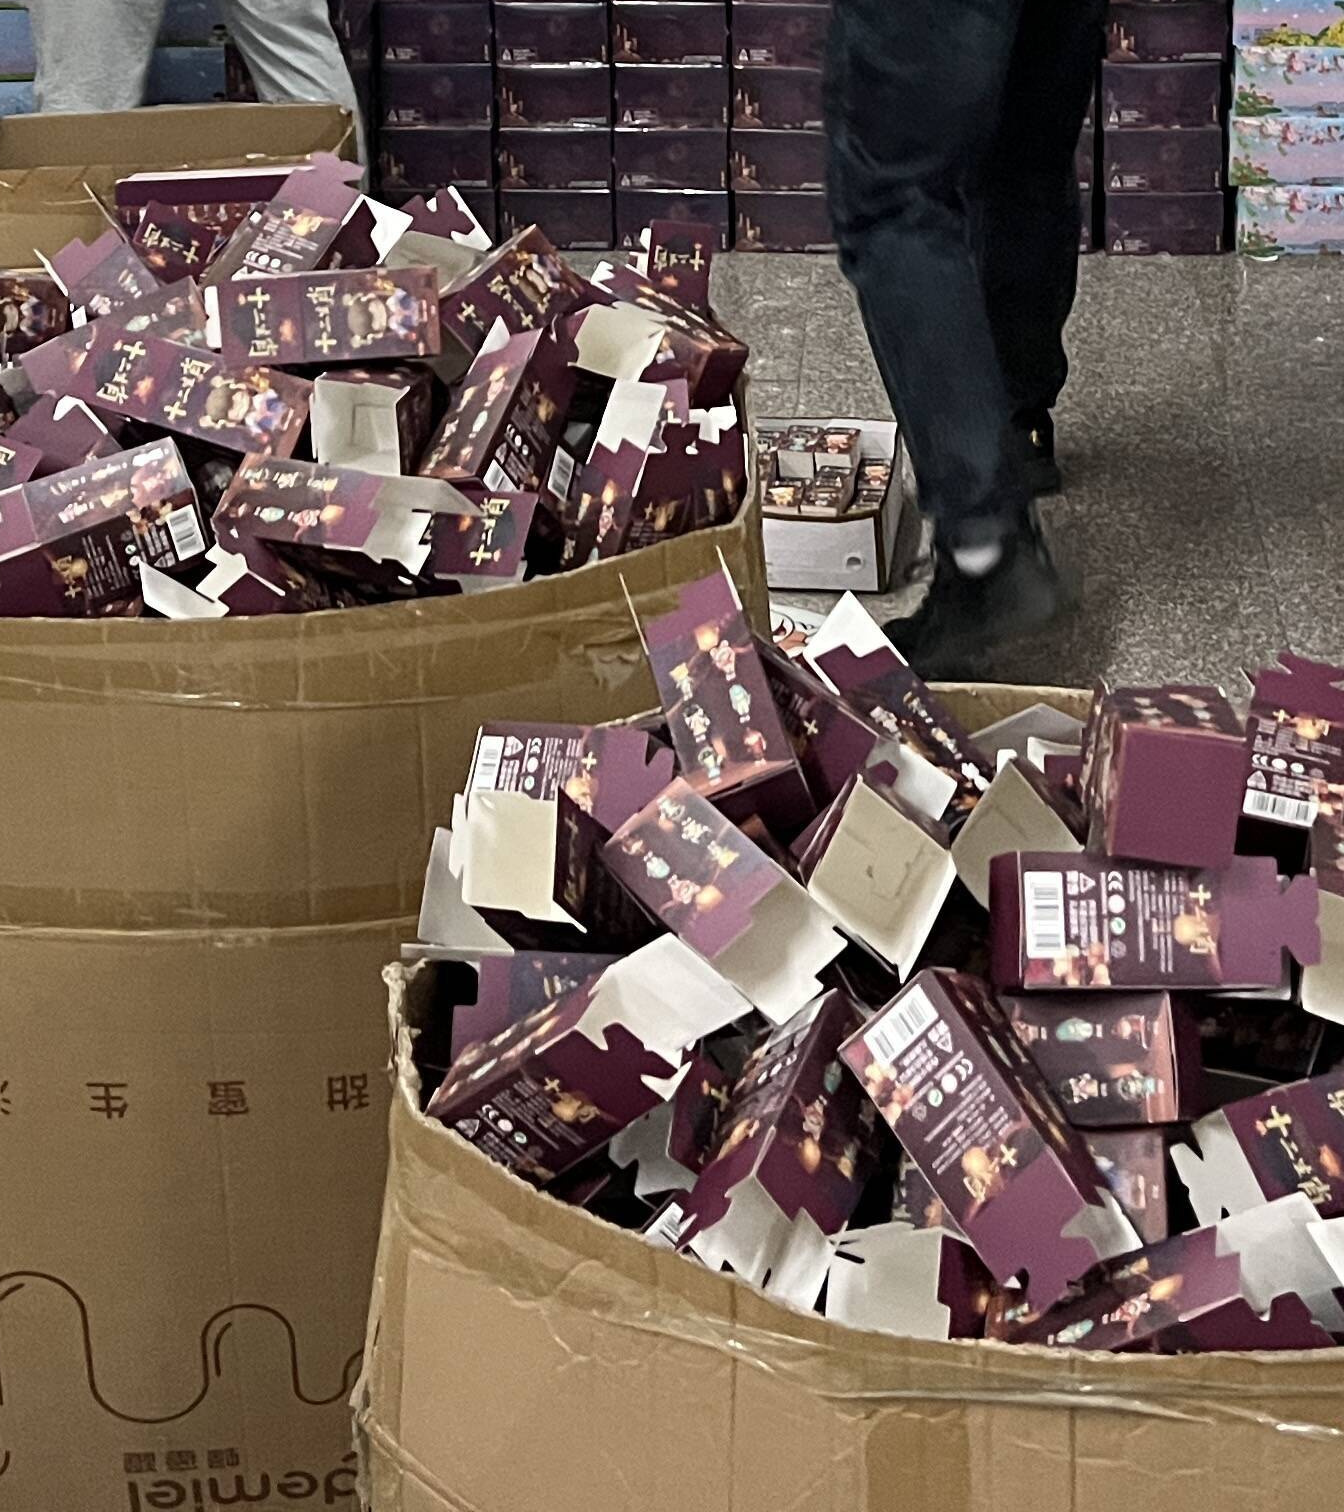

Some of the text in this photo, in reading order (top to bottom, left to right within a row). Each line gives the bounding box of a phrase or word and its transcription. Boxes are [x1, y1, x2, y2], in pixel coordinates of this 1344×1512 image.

[246, 285, 280, 358] 十二生肖
[306, 282, 338, 355] 十二生肖
[96, 340, 148, 406] 十二生肖
[163, 356, 214, 423] 十二生肖
[468, 497, 511, 568] 十二生肖
